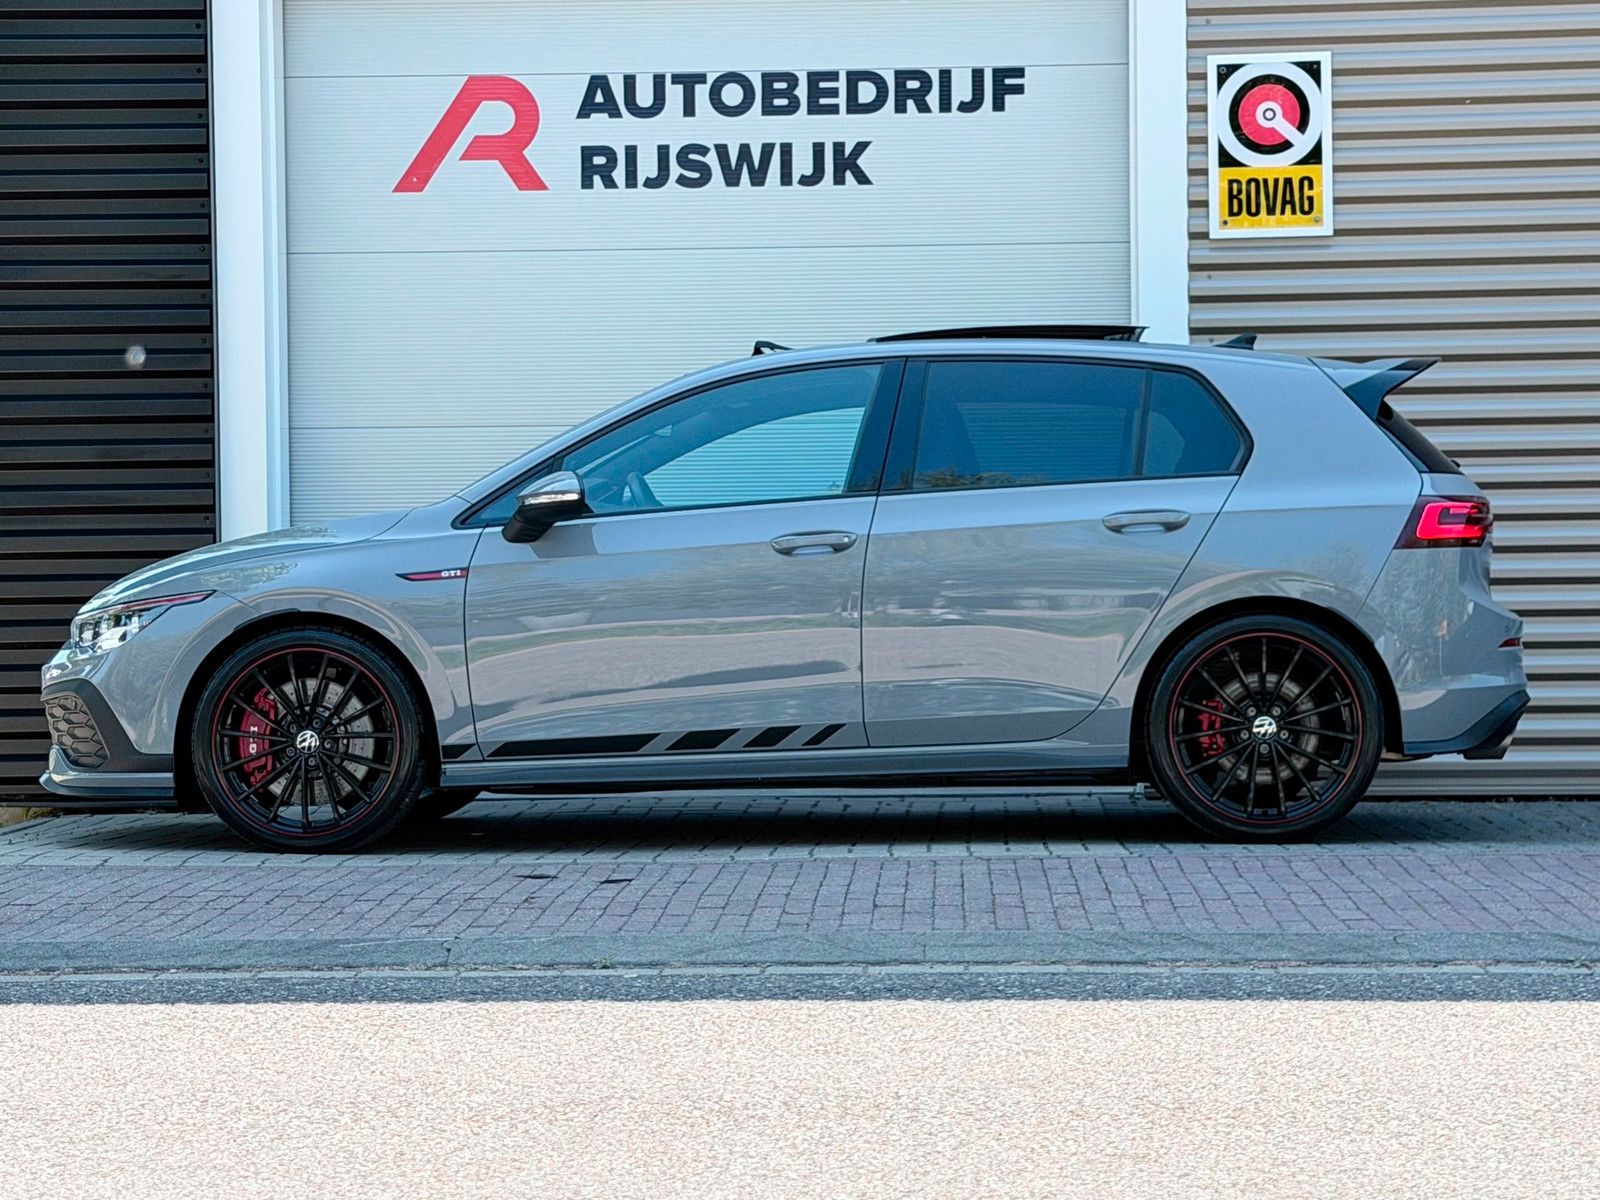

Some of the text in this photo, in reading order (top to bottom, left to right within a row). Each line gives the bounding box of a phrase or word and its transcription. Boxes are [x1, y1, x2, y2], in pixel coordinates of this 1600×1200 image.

[576, 67, 1025, 119] AUTOBEDRIJF
[581, 141, 873, 190] RIJSWIJK
[1227, 175, 1314, 218] BOVAG
[441, 569, 461, 577] GTI
